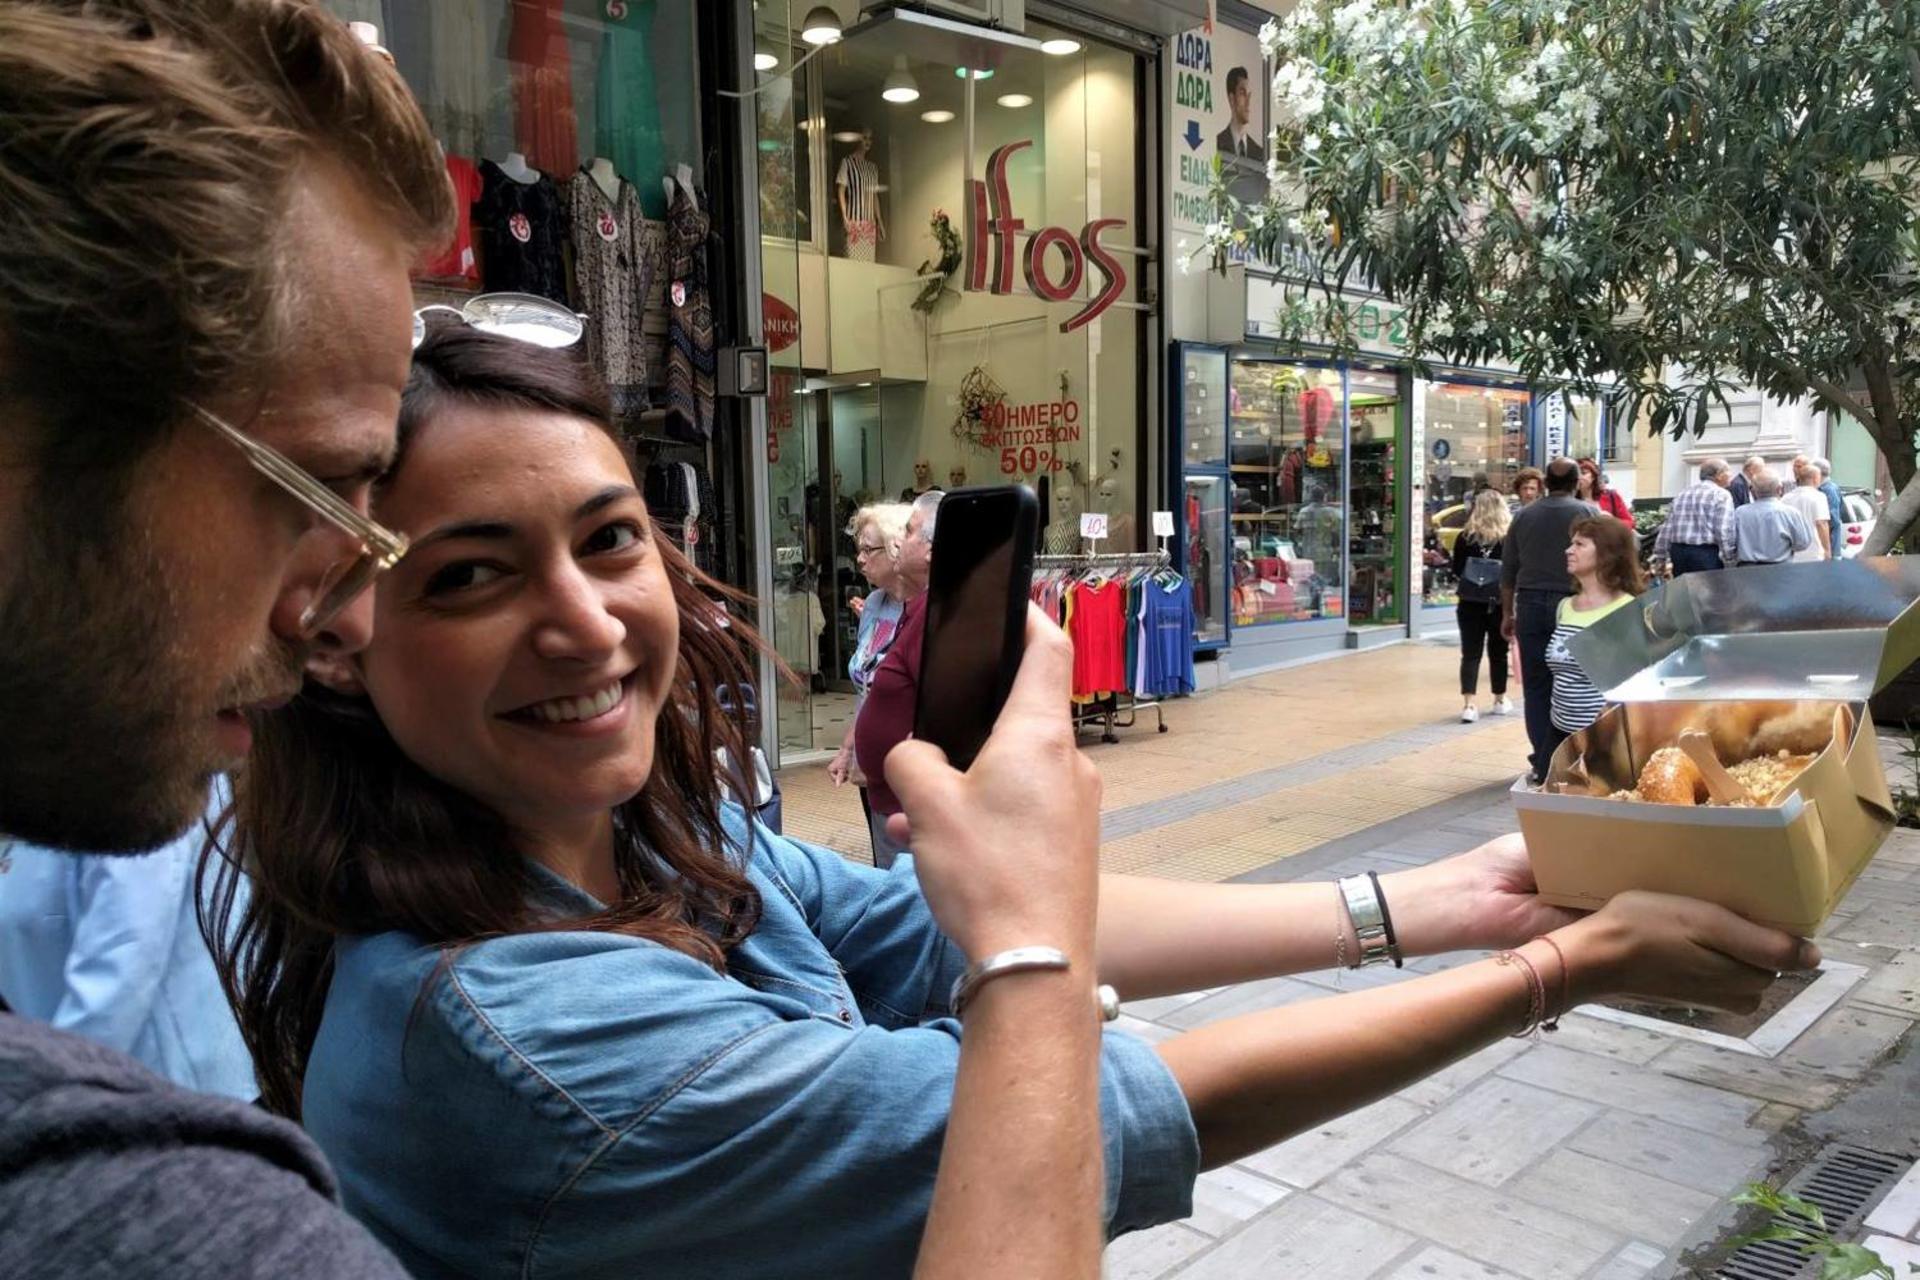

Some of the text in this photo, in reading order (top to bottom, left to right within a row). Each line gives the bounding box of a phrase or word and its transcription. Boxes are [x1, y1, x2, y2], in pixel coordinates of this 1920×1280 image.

[1176, 32, 1212, 74] ΔΩΡΑ
[1176, 71, 1213, 113] ΔΩΡΑ
[1180, 153, 1210, 187] ΕΙΔΗ
[1001, 446, 1063, 474] 50%
